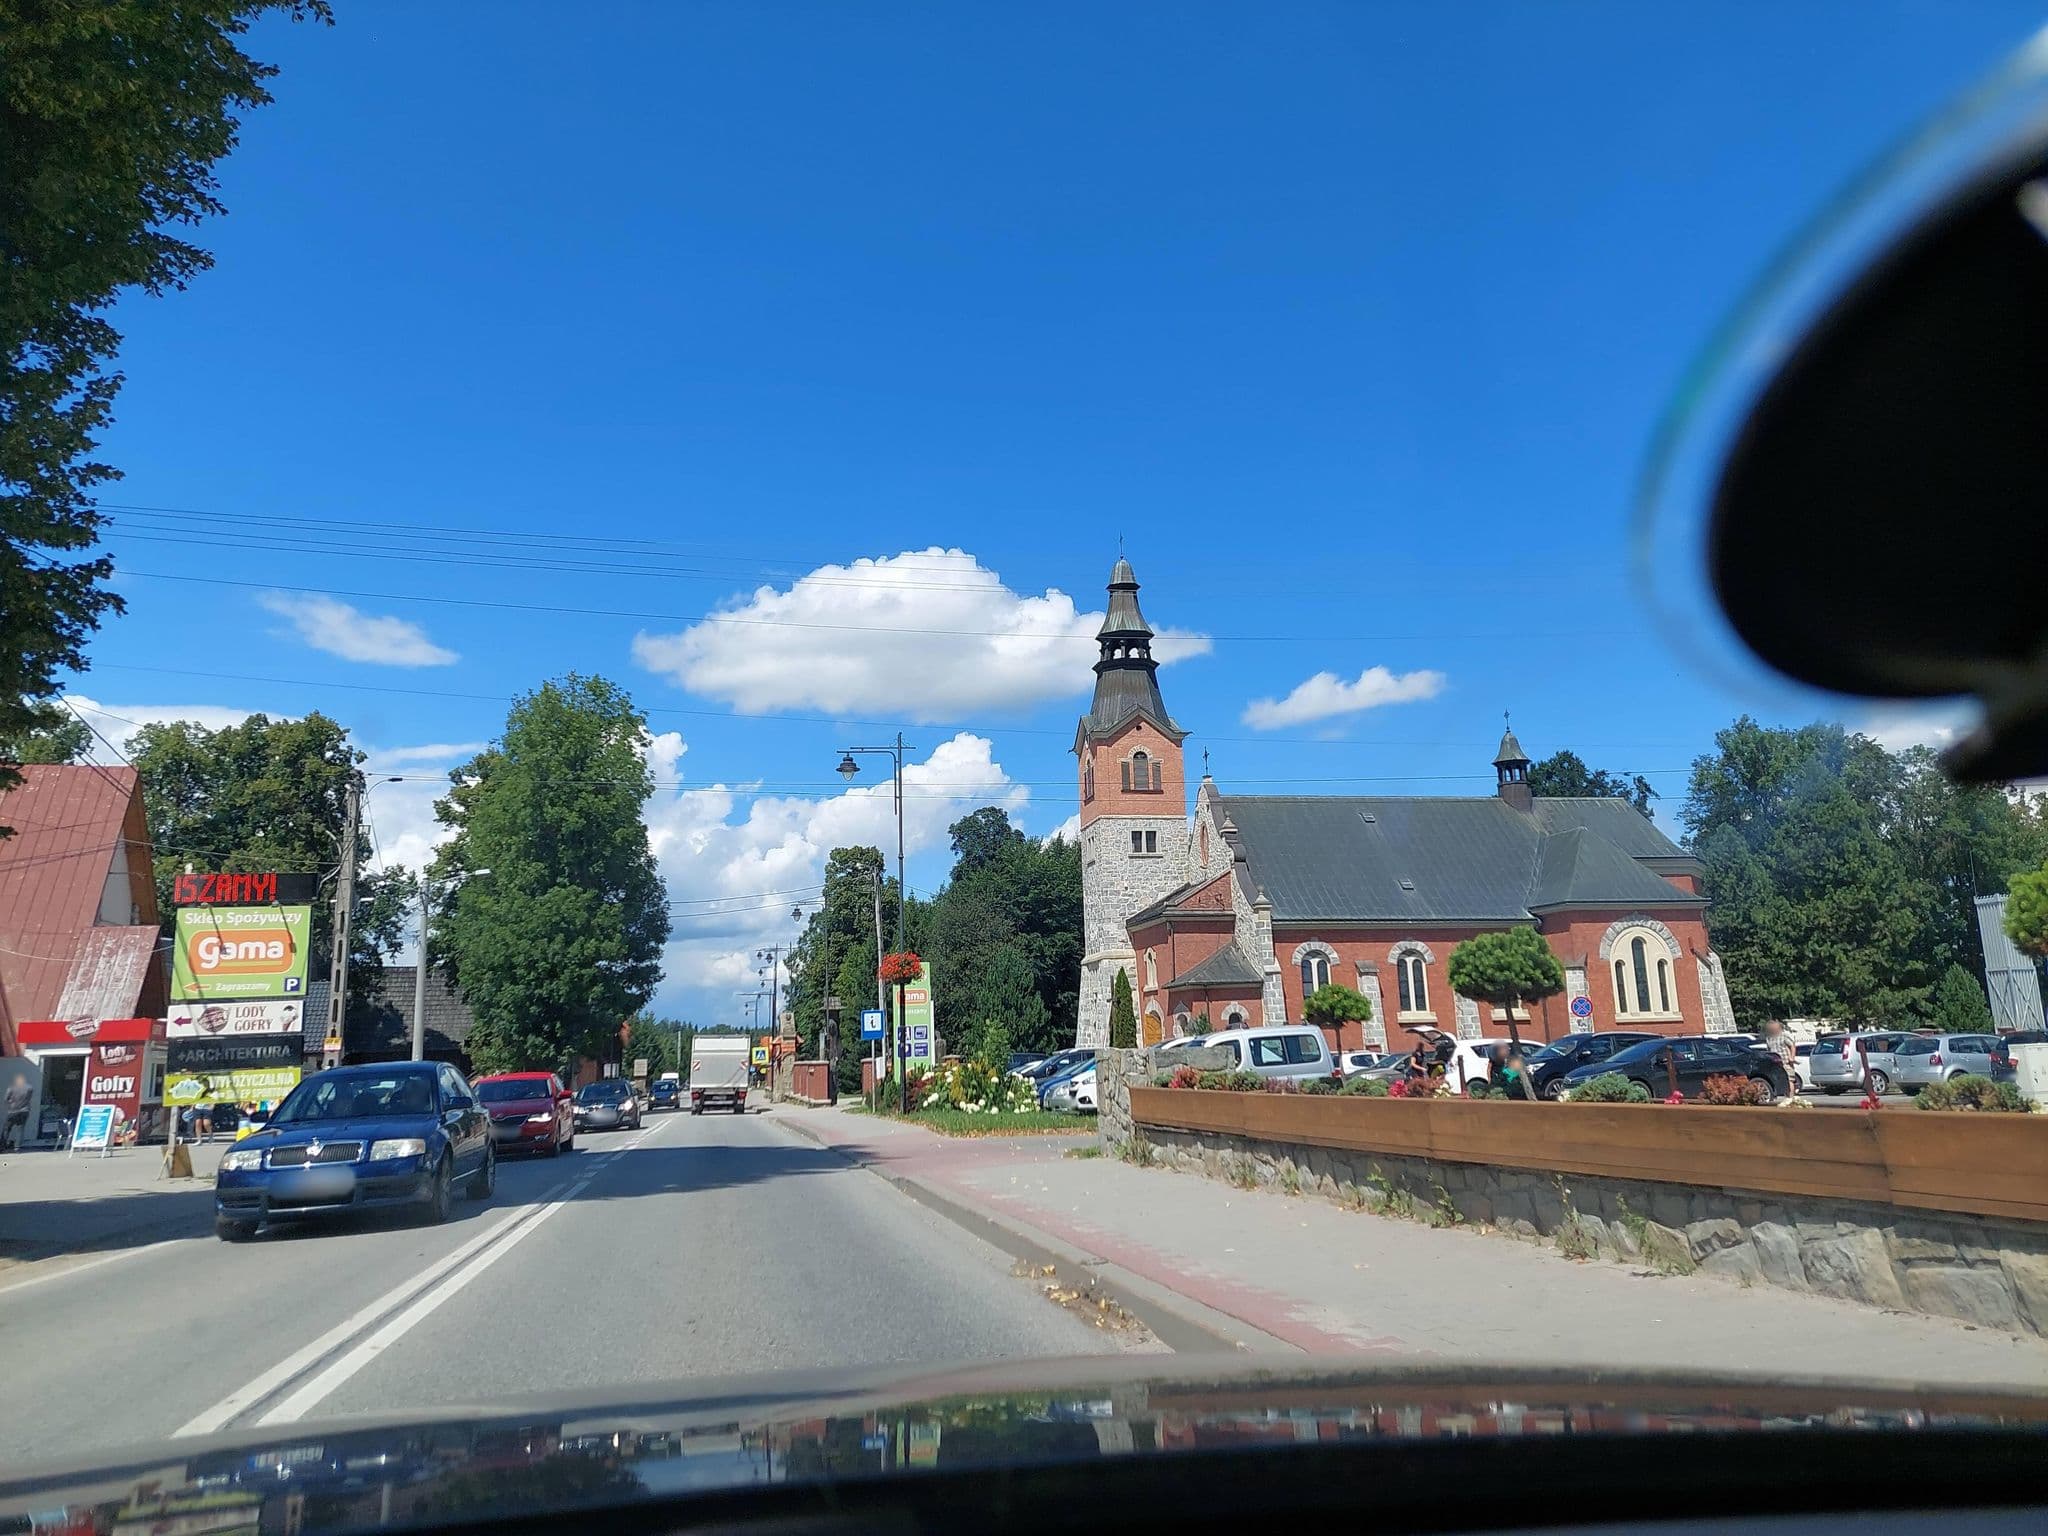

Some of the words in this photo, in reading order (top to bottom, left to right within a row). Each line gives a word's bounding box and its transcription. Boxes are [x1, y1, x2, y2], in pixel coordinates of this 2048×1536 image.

[184, 912, 223, 924] Sklep
[226, 911, 302, 926] Spożywczy
[198, 936, 284, 969] gama
[215, 982, 271, 993] Zapraszamy
[286, 978, 298, 991] P
[234, 1006, 267, 1018] LODY
[234, 1019, 274, 1031] GOFRY
[99, 1045, 127, 1059] Lody
[91, 1075, 135, 1093] Gofry
